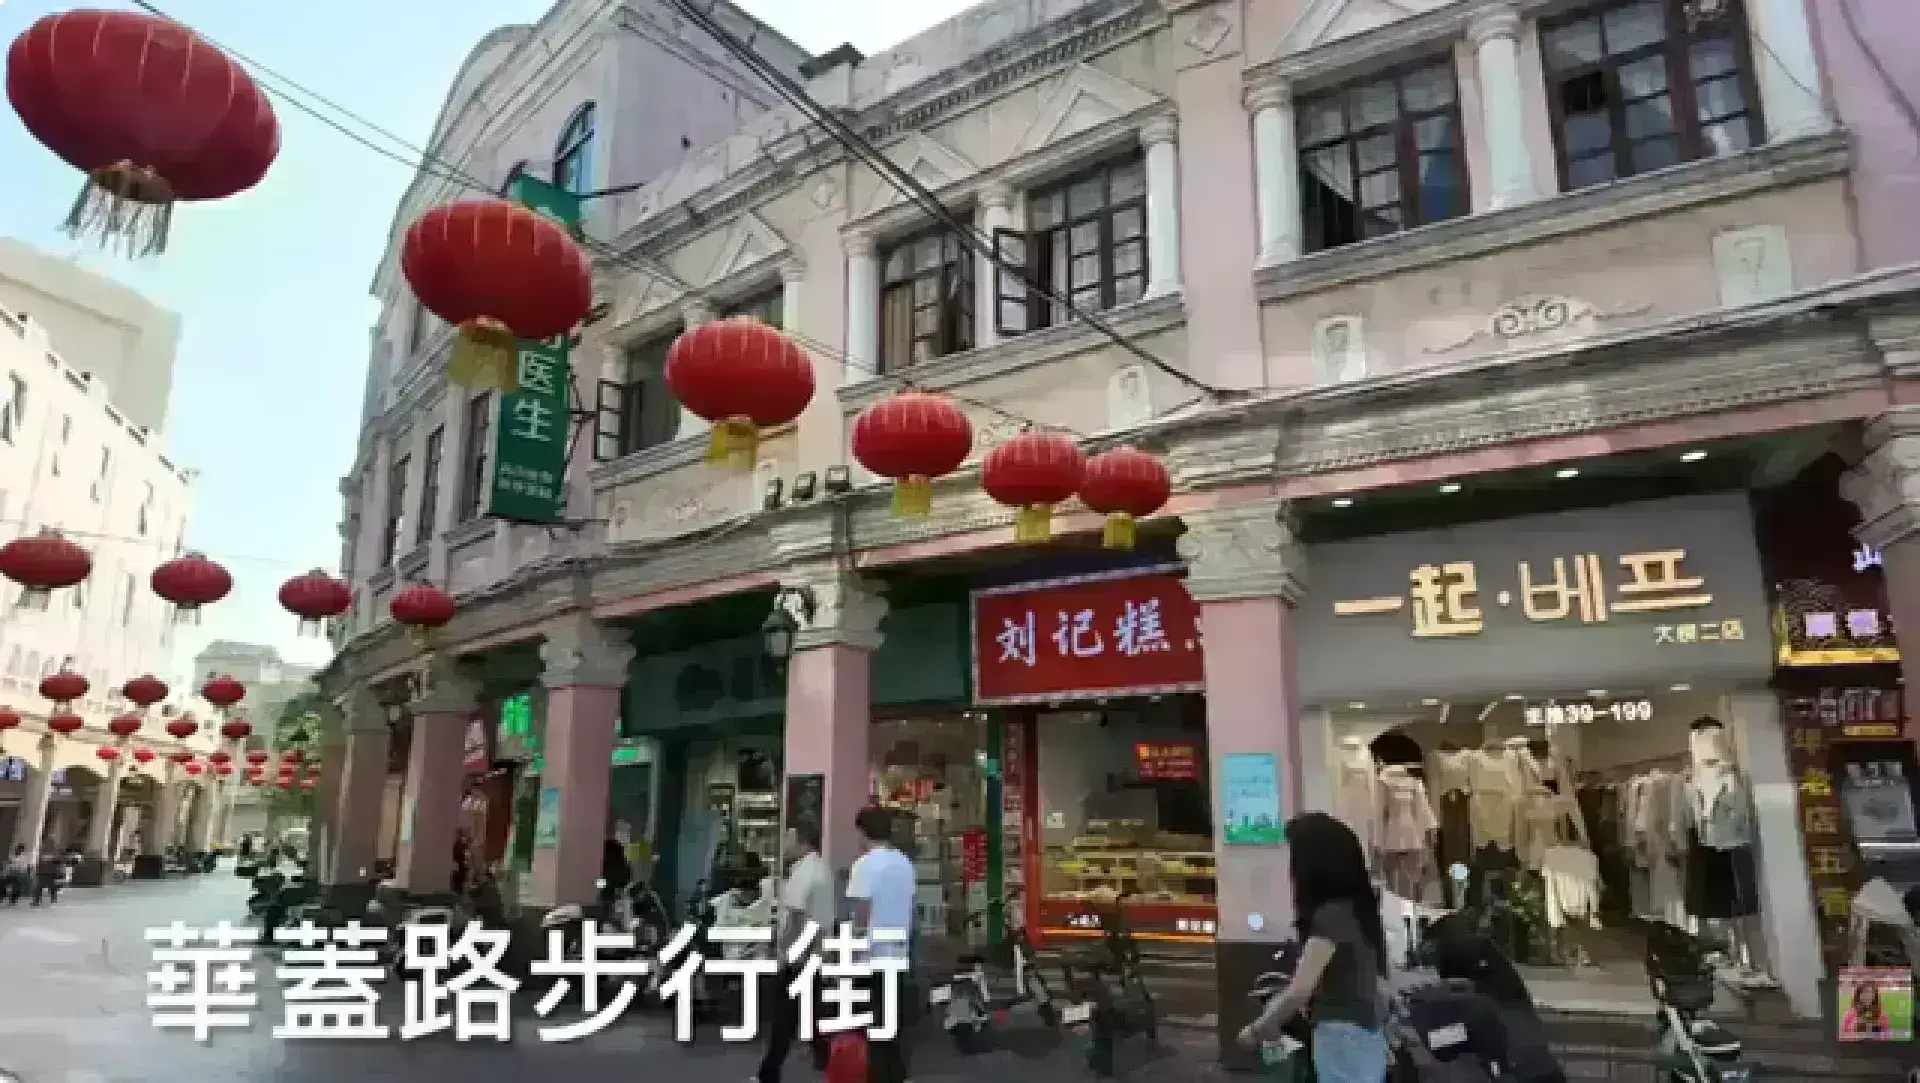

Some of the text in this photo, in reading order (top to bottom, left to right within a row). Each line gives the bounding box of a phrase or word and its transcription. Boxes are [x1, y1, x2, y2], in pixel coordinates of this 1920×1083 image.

[510, 334, 558, 442] 医生
[995, 597, 1204, 667] 刘记糕
